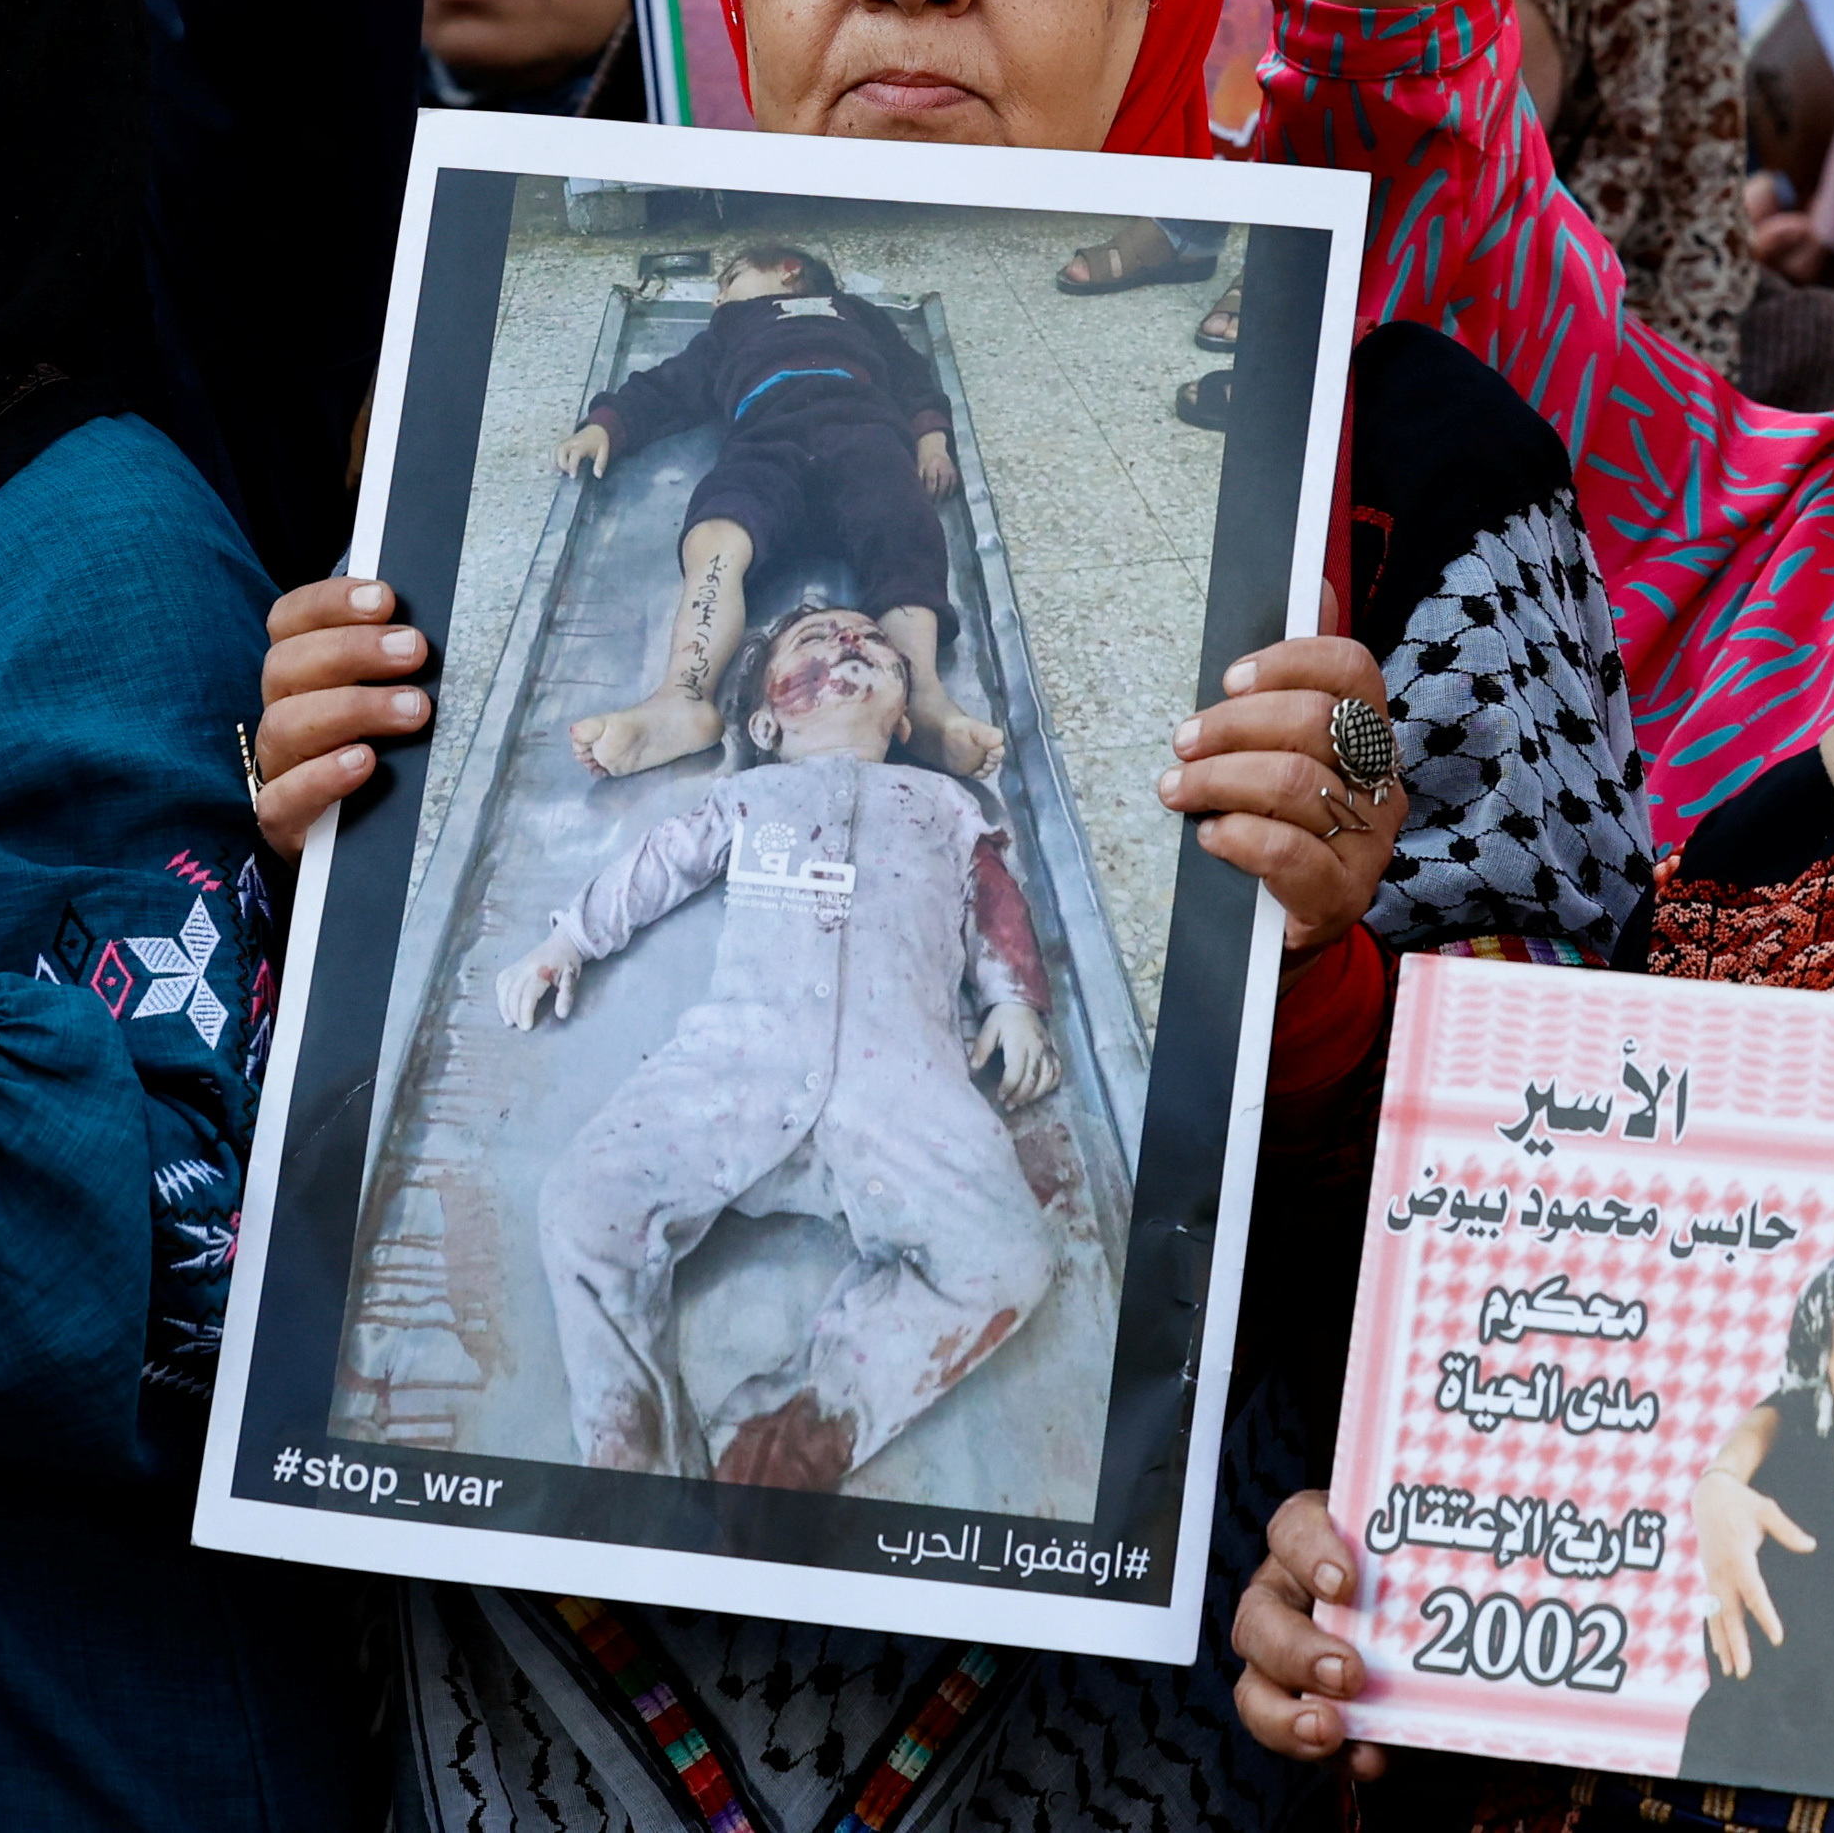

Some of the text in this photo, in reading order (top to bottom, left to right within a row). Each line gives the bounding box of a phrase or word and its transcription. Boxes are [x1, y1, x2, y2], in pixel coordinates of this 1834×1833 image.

[1497, 1039, 1689, 1156] الأسير
[1387, 1167, 1797, 1263] حابس محمود بيوض
[1480, 1275, 1648, 1345] محكوم
[1437, 1352, 1660, 1435] مدى الحياة
[273, 1446, 503, 1508] #stop_war
[877, 1524, 1152, 1586] #اوقفوا_الحرب
[1366, 1483, 1667, 1579] تاريخ الإعتقال
[1413, 1585, 1628, 1693] 2002
